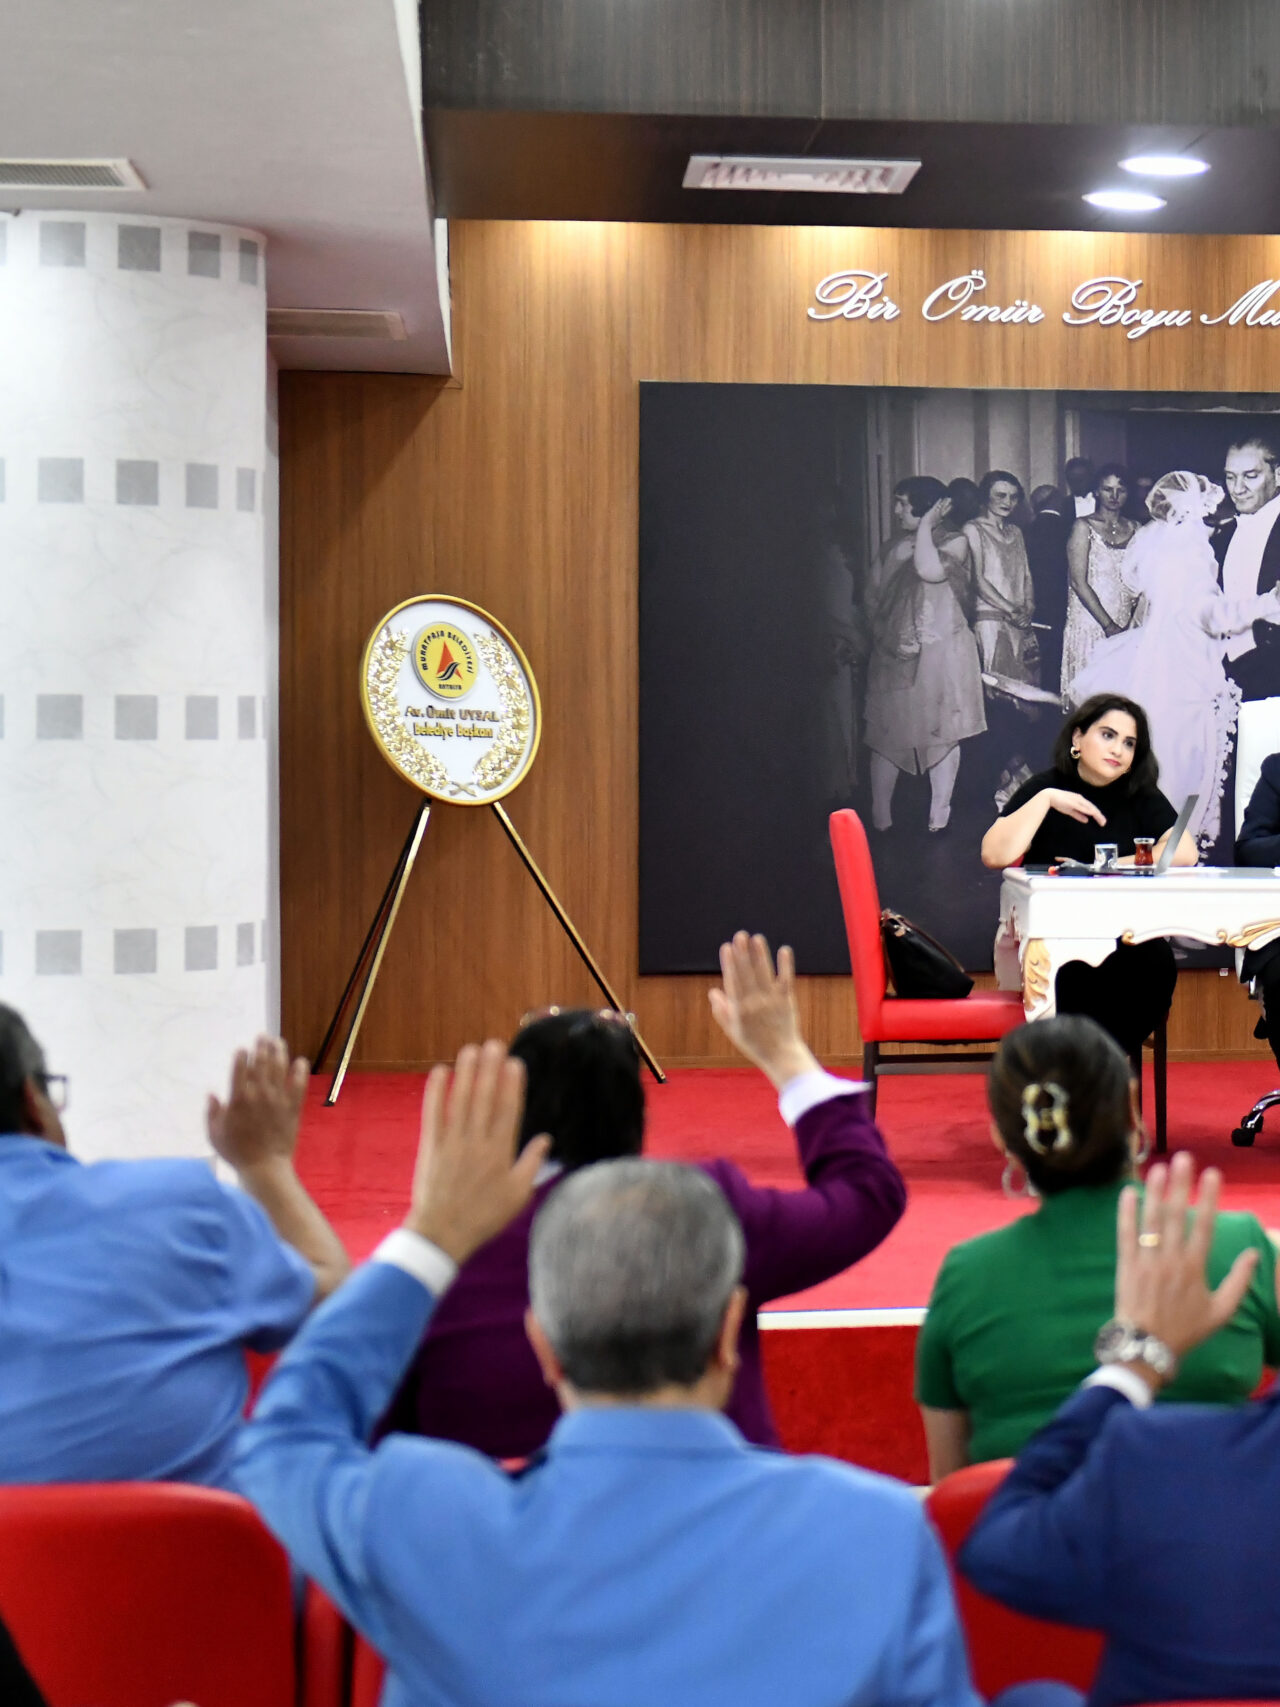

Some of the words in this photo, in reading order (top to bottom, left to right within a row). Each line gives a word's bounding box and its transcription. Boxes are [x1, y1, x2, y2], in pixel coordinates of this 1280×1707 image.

[807, 268, 901, 322] Bir
[921, 268, 1046, 323] Ömür
[1062, 276, 1191, 340] Boyu
[404, 705, 425, 718] Av.
[426, 705, 456, 719] Ümit
[459, 709, 500, 722] UYSAL
